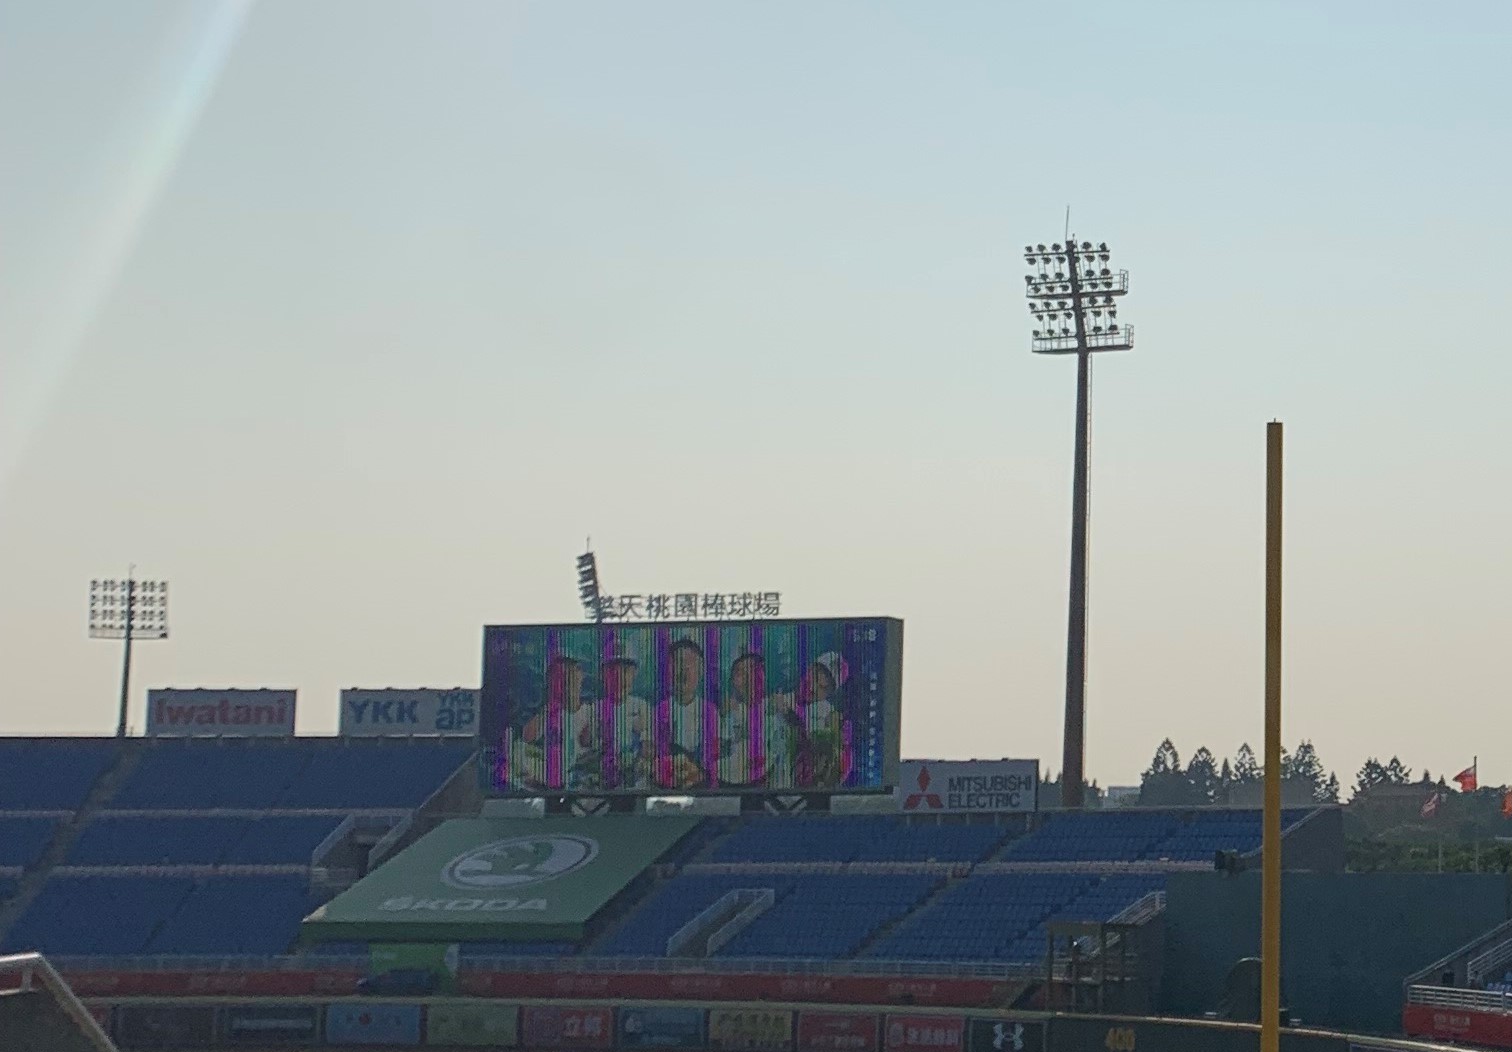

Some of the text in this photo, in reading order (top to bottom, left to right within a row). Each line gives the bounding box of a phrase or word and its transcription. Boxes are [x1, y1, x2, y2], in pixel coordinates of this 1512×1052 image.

[155, 699, 286, 726] Iwatani
[349, 700, 418, 723] YKK
[435, 708, 474, 732] ap
[948, 775, 1031, 792] MITSUBISHI
[948, 793, 1021, 809] ELECTRIC
